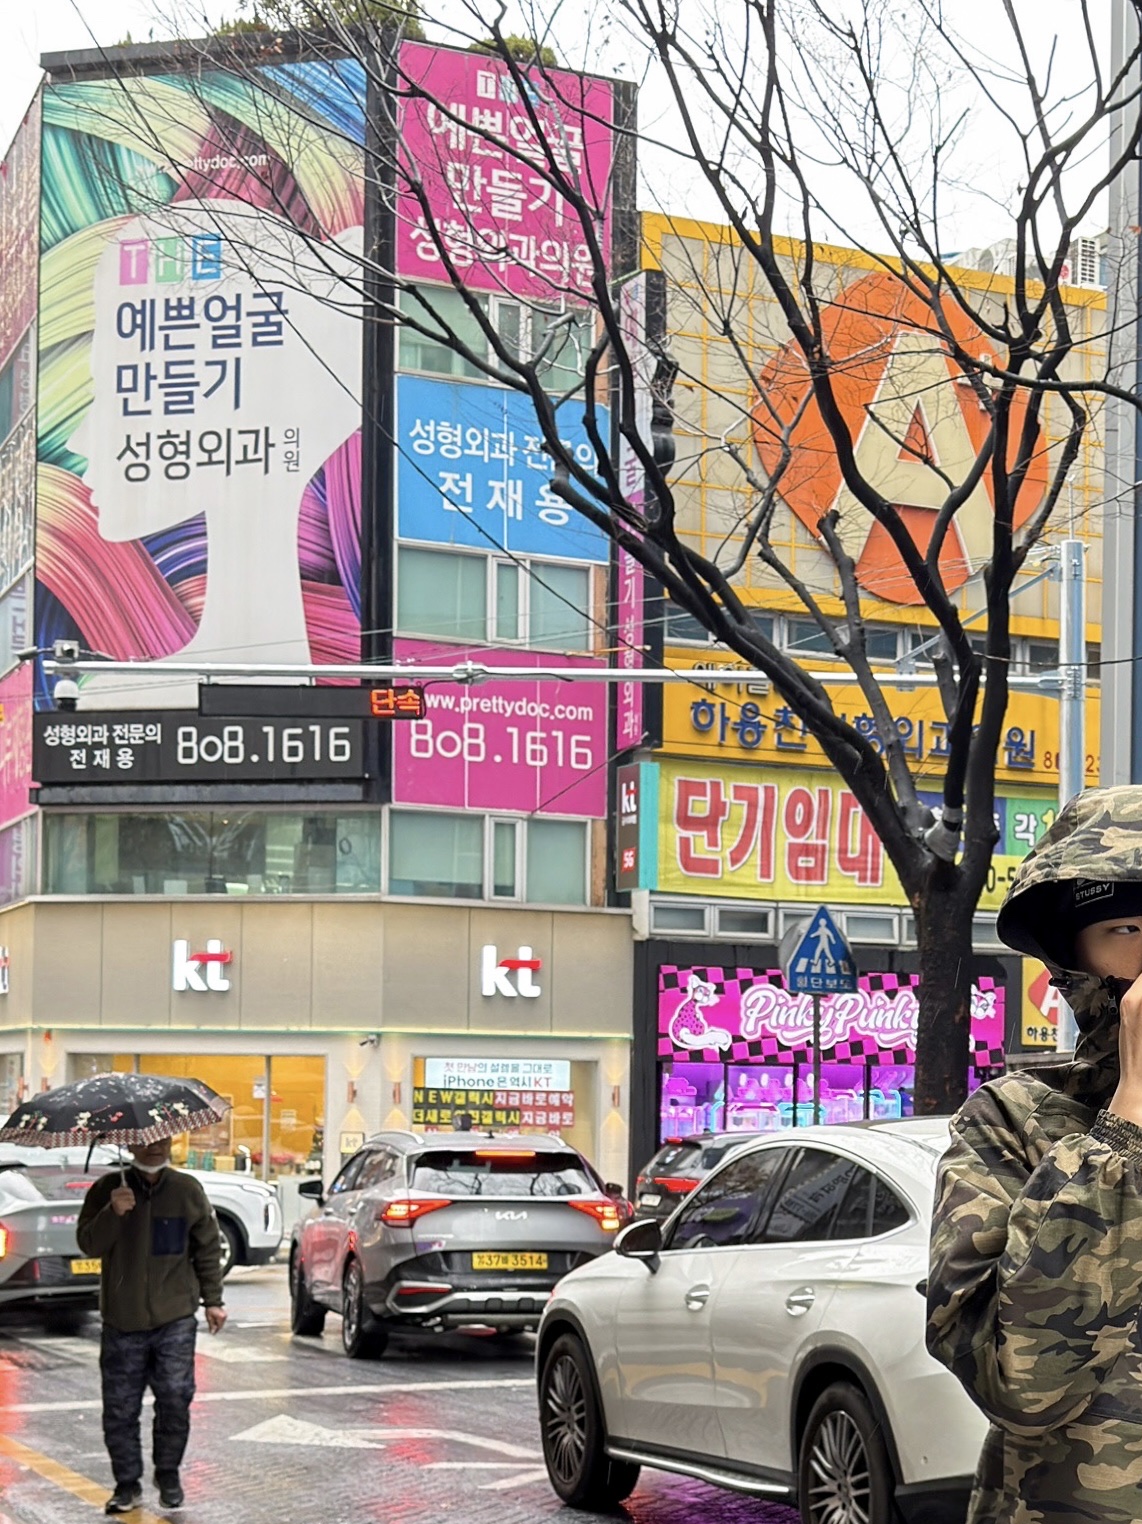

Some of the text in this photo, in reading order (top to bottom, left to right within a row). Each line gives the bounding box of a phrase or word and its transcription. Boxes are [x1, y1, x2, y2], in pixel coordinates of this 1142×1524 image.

[447, 160, 566, 228] 만들기
[121, 236, 221, 282] THE
[116, 291, 289, 353] 예쁜얼굴
[116, 357, 241, 417] 만들기
[116, 426, 300, 483] 성형외과 의원
[409, 418, 518, 467] 성형외과
[523, 435, 598, 478] 전의
[370, 689, 421, 717] 단속
[424, 692, 593, 721] ww.prettydoc.com
[43, 724, 162, 746] 성형외과 전문의
[176, 725, 351, 765] 808.1616
[410, 719, 593, 770] 808.1616
[622, 781, 637, 814] kt
[675, 777, 885, 887] 단기임대
[1075, 882, 1110, 900] STUSSY
[173, 940, 233, 991] kt
[482, 945, 542, 998] kt
[744, 988, 834, 1042] Pinky
